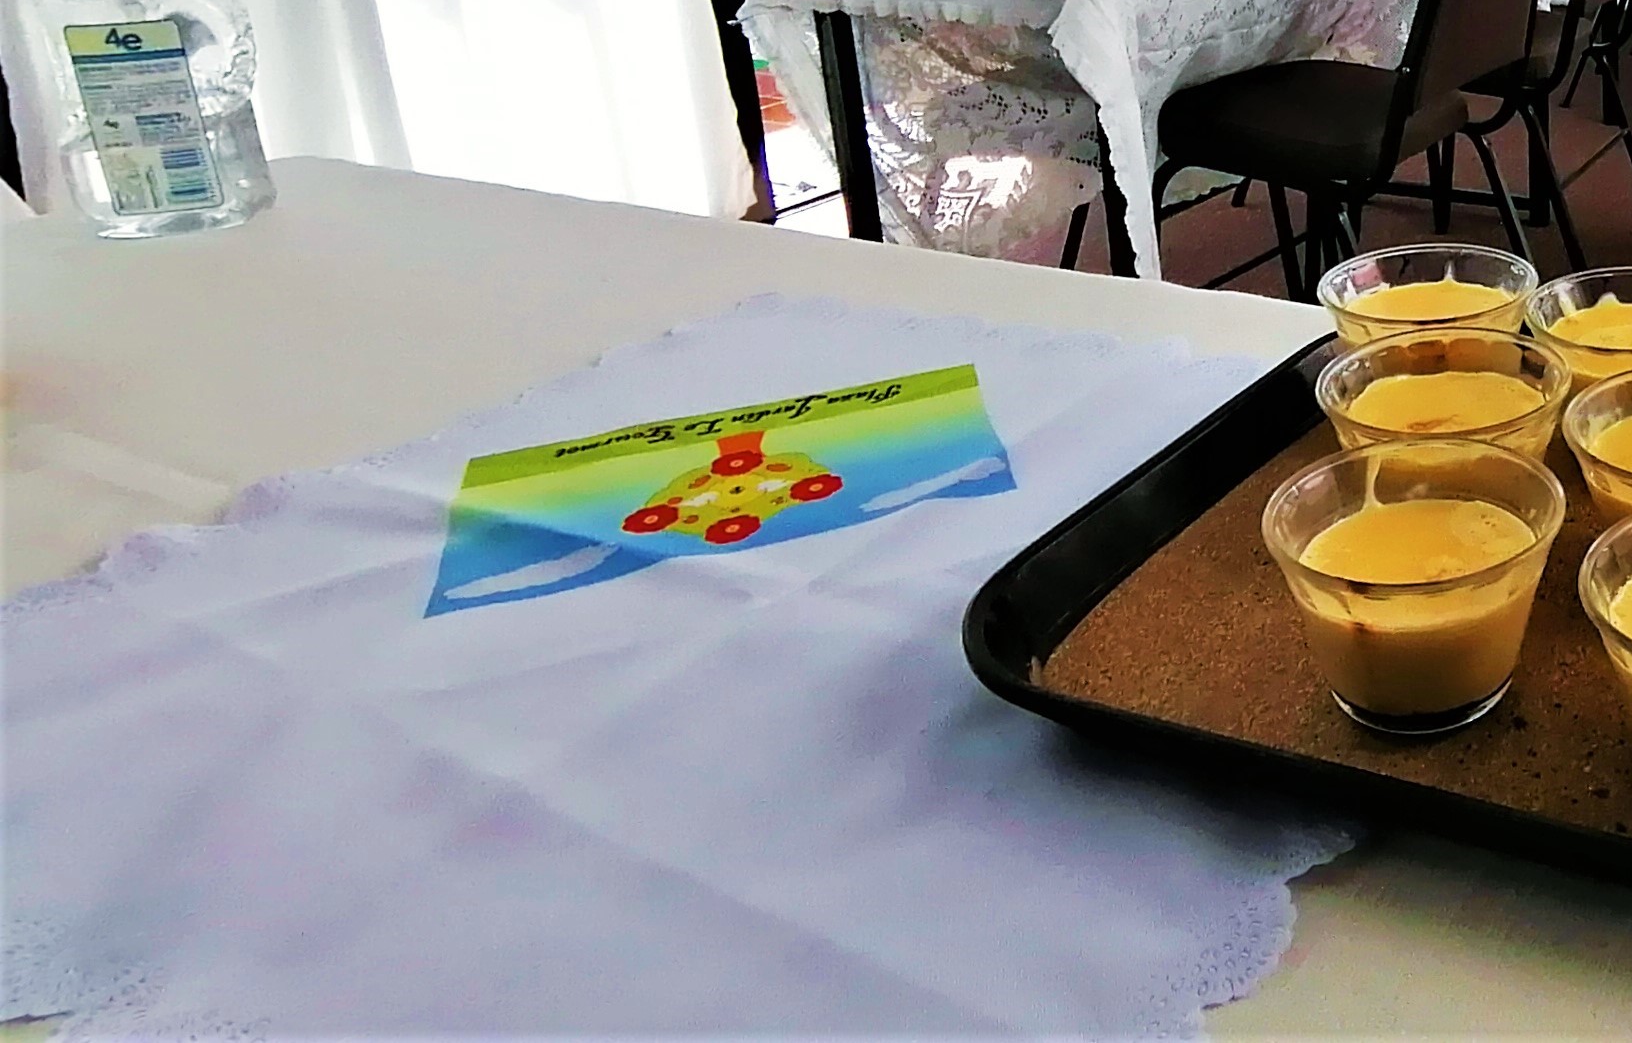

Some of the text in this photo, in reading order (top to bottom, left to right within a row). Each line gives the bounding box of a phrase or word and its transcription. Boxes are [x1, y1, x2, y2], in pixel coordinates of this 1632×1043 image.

[104, 27, 143, 51] 4e
[827, 384, 902, 405] Plaza
[555, 425, 675, 458] Gourmet
